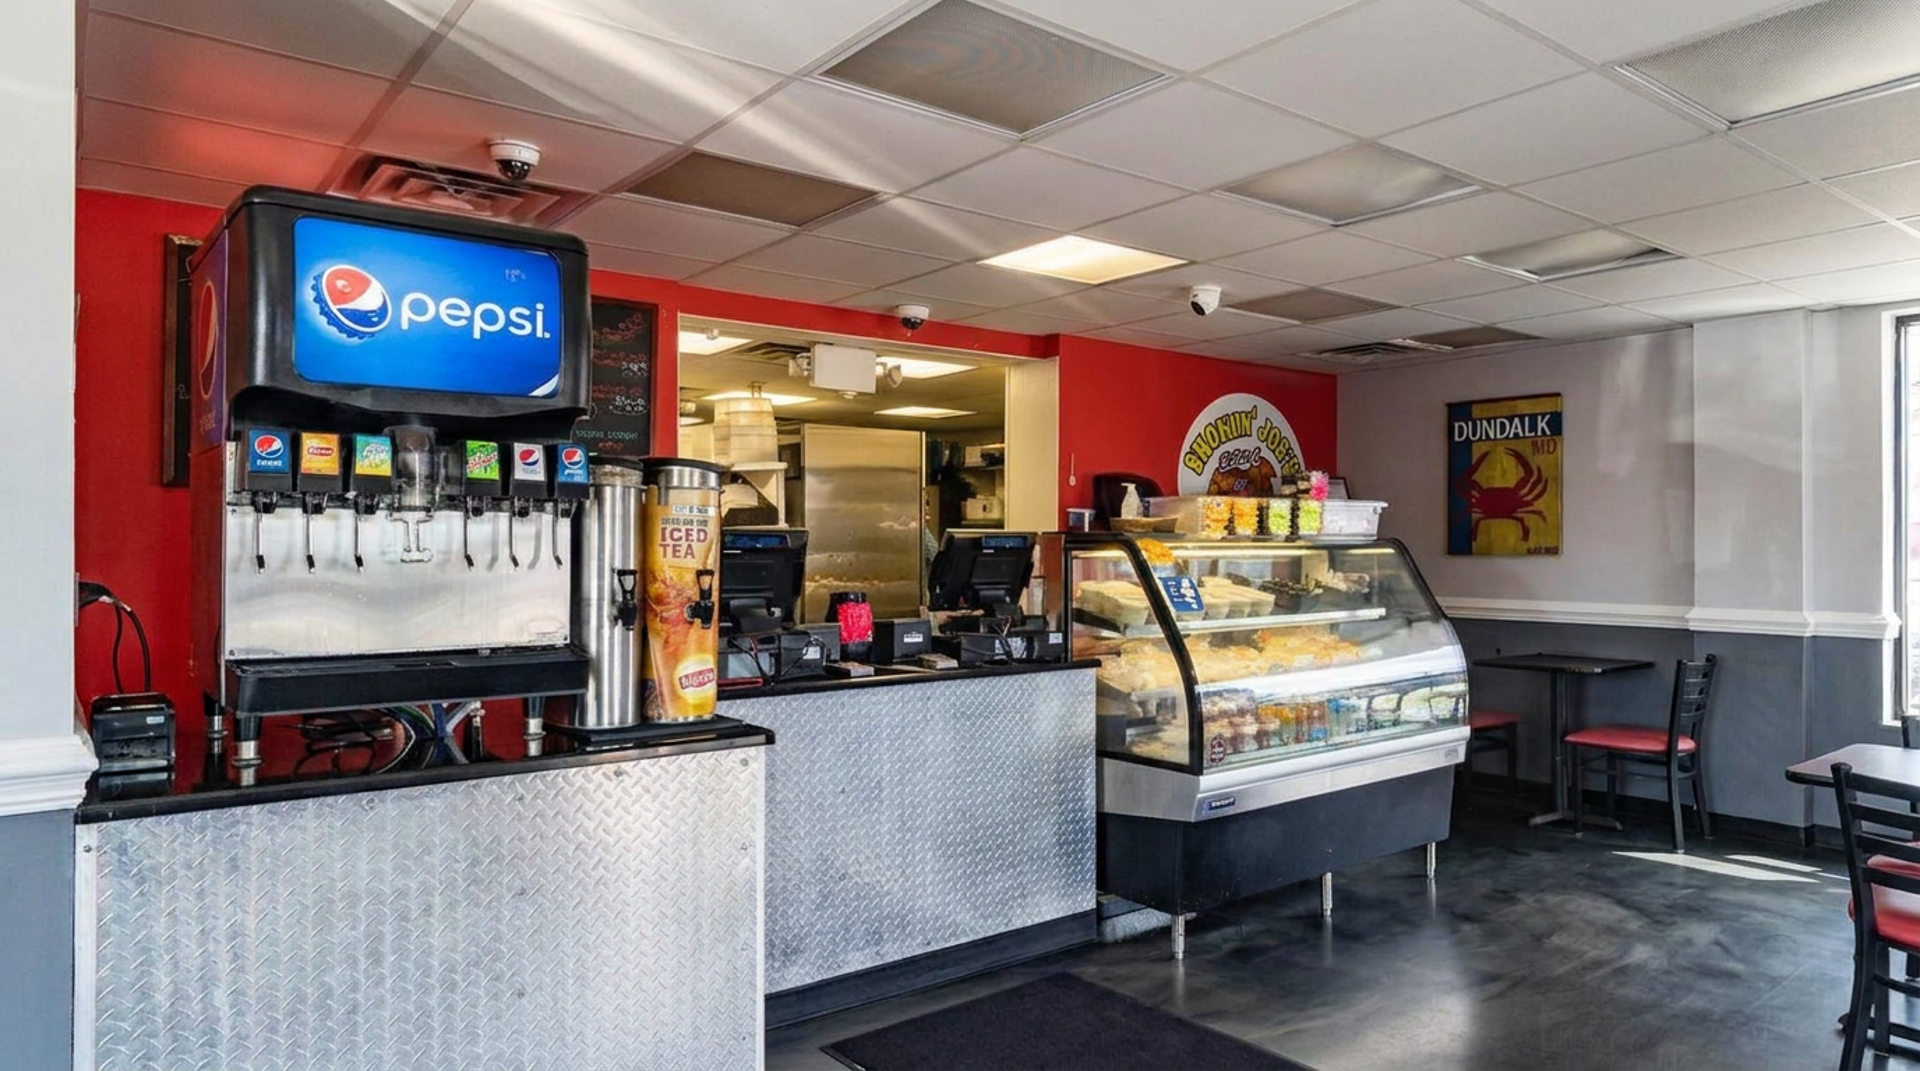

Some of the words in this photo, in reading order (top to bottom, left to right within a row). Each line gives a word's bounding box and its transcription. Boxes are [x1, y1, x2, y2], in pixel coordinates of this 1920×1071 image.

[1454, 414, 1551, 442] DUNDALK
[1531, 438, 1557, 456] MD
[660, 527, 708, 543] ICED
[659, 543, 696, 559] TEA
